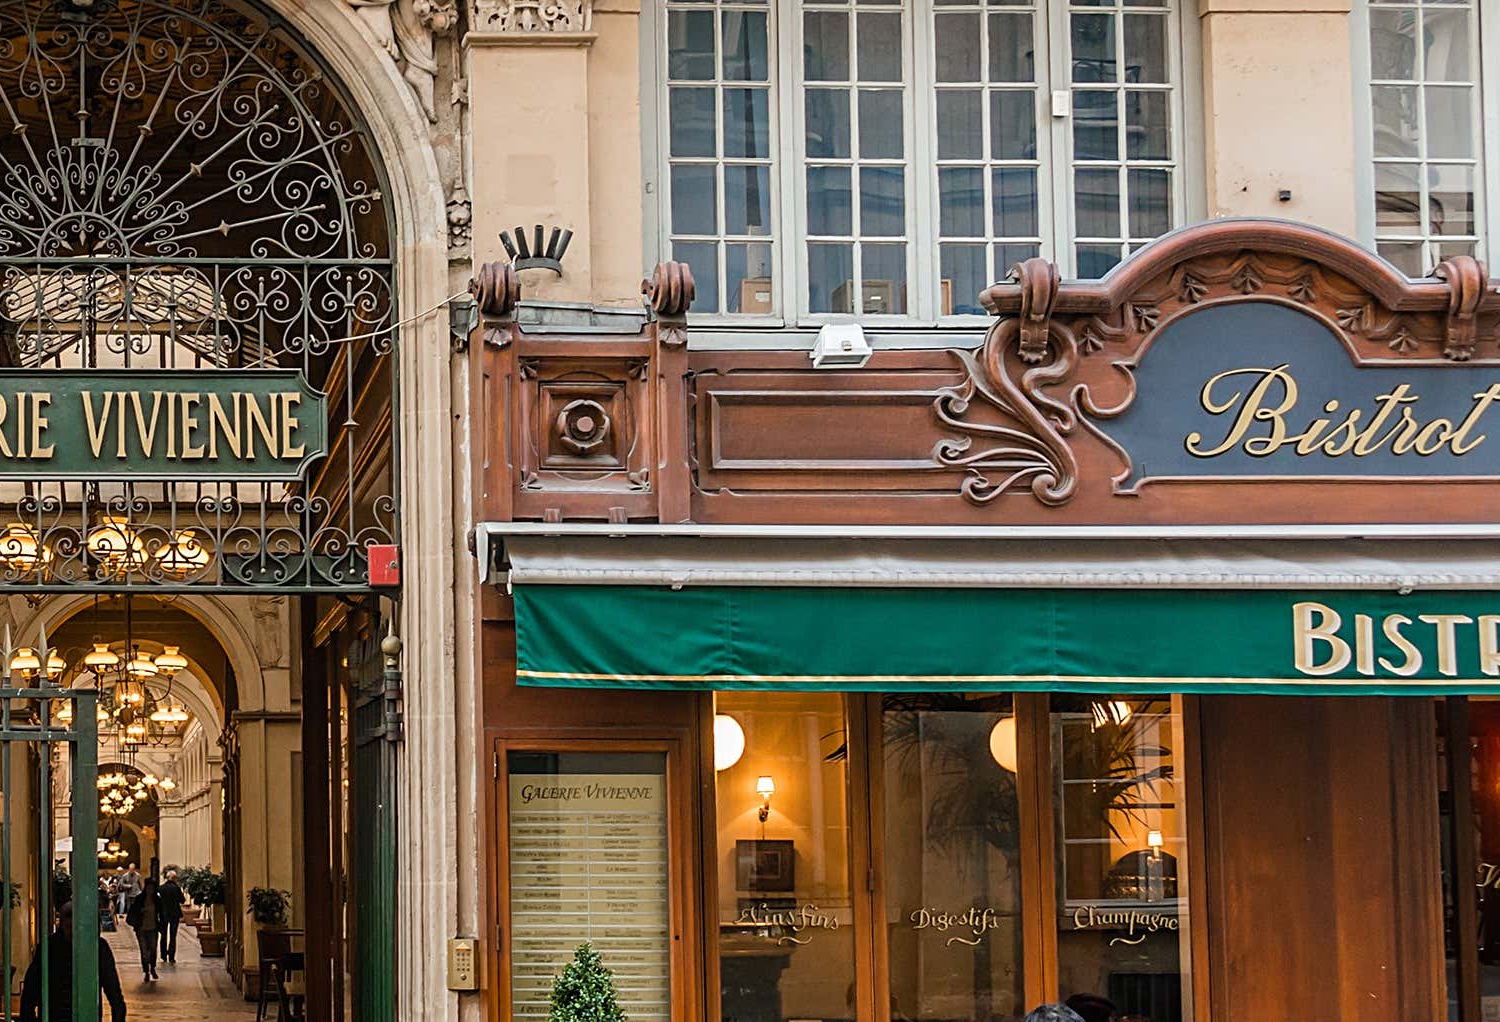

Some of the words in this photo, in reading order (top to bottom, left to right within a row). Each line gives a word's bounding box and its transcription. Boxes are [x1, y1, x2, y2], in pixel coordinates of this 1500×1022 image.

[81, 390, 306, 460] VIVIENNE
[1185, 363, 1500, 457] Bistrot
[521, 784, 581, 804] GALERIE
[583, 782, 653, 800] VIVIENNE
[793, 903, 839, 932] fins
[910, 906, 1000, 935] Digestifs
[1073, 904, 1179, 936] Champagne
